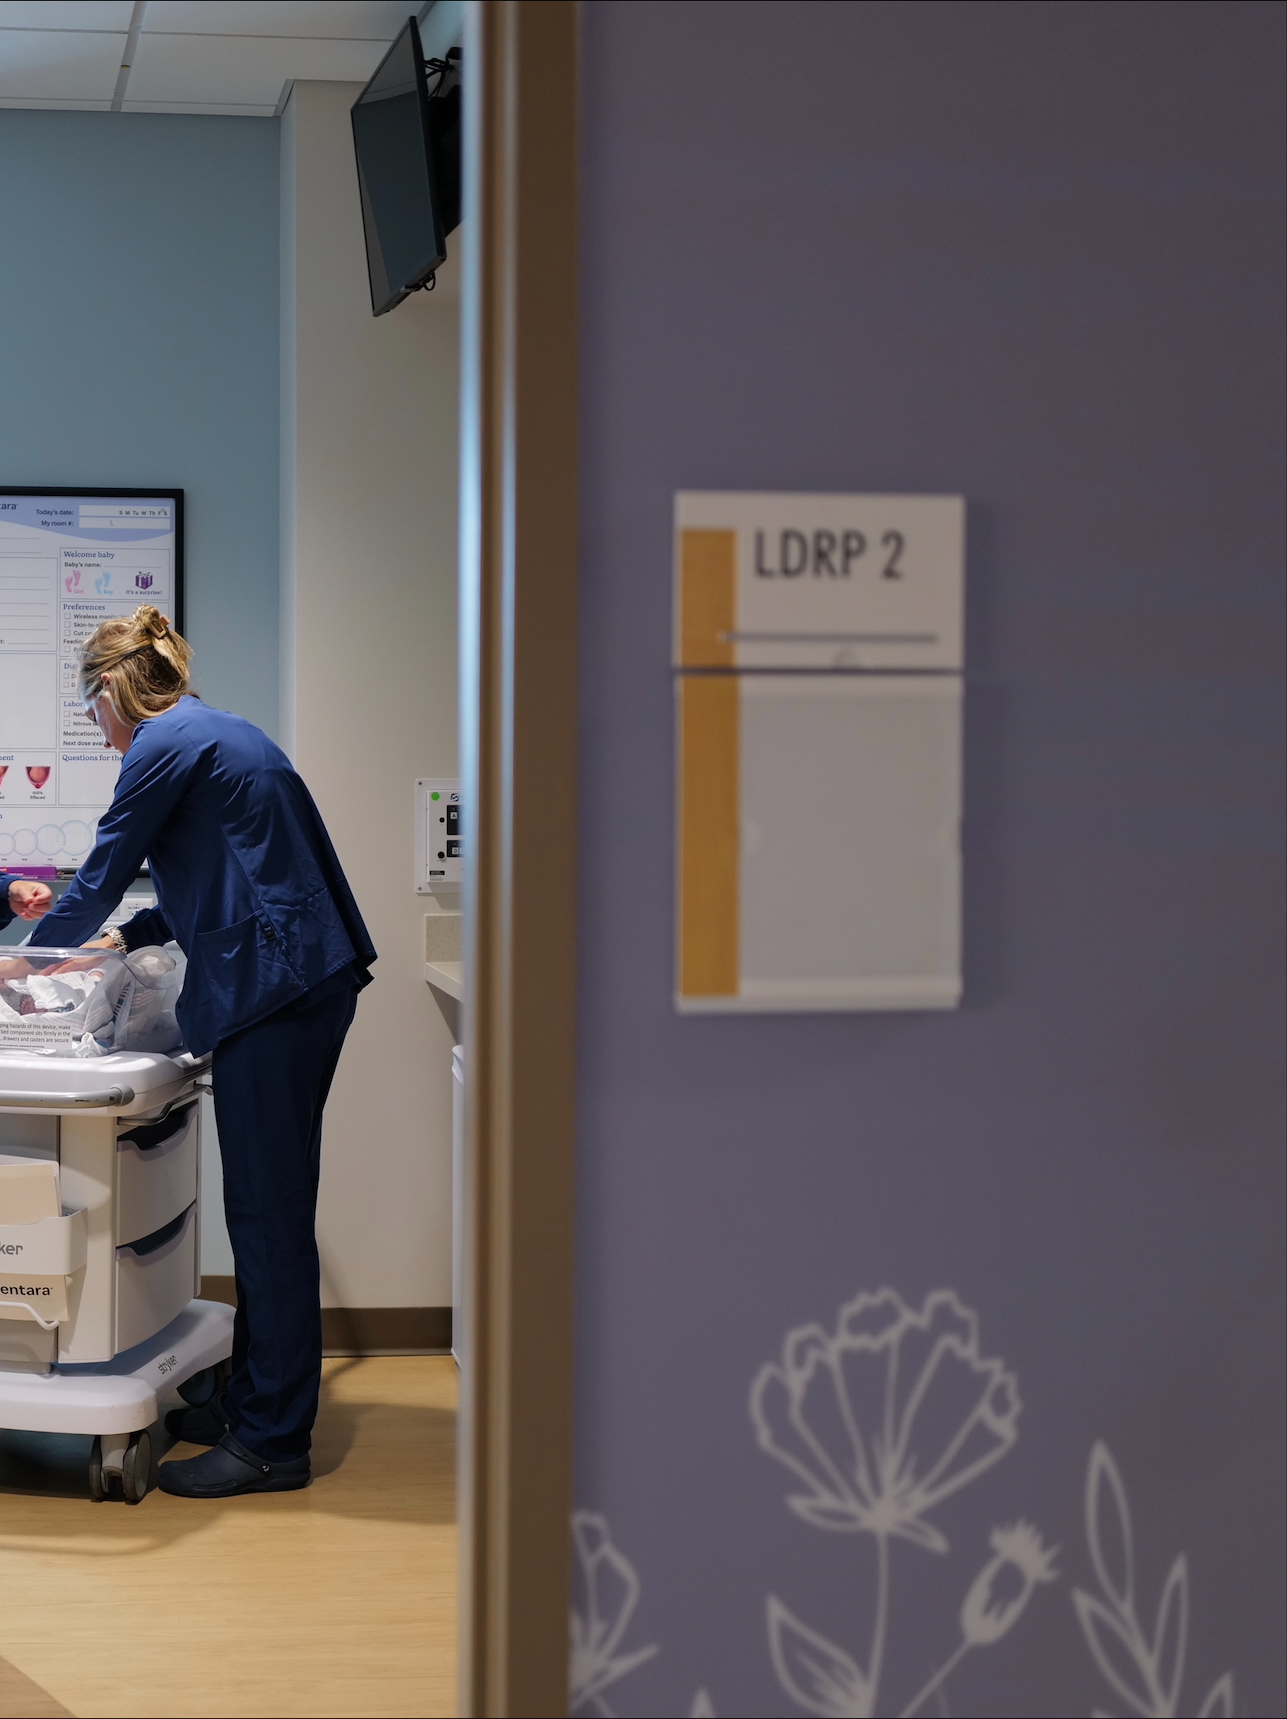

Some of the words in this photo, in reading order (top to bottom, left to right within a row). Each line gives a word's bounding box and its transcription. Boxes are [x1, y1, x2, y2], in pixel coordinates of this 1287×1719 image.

[98, 551, 115, 559] baby
[754, 527, 868, 579] LDRP
[881, 527, 905, 580] 2
[62, 754, 98, 762] Questions
[157, 1355, 179, 1375] stryker
